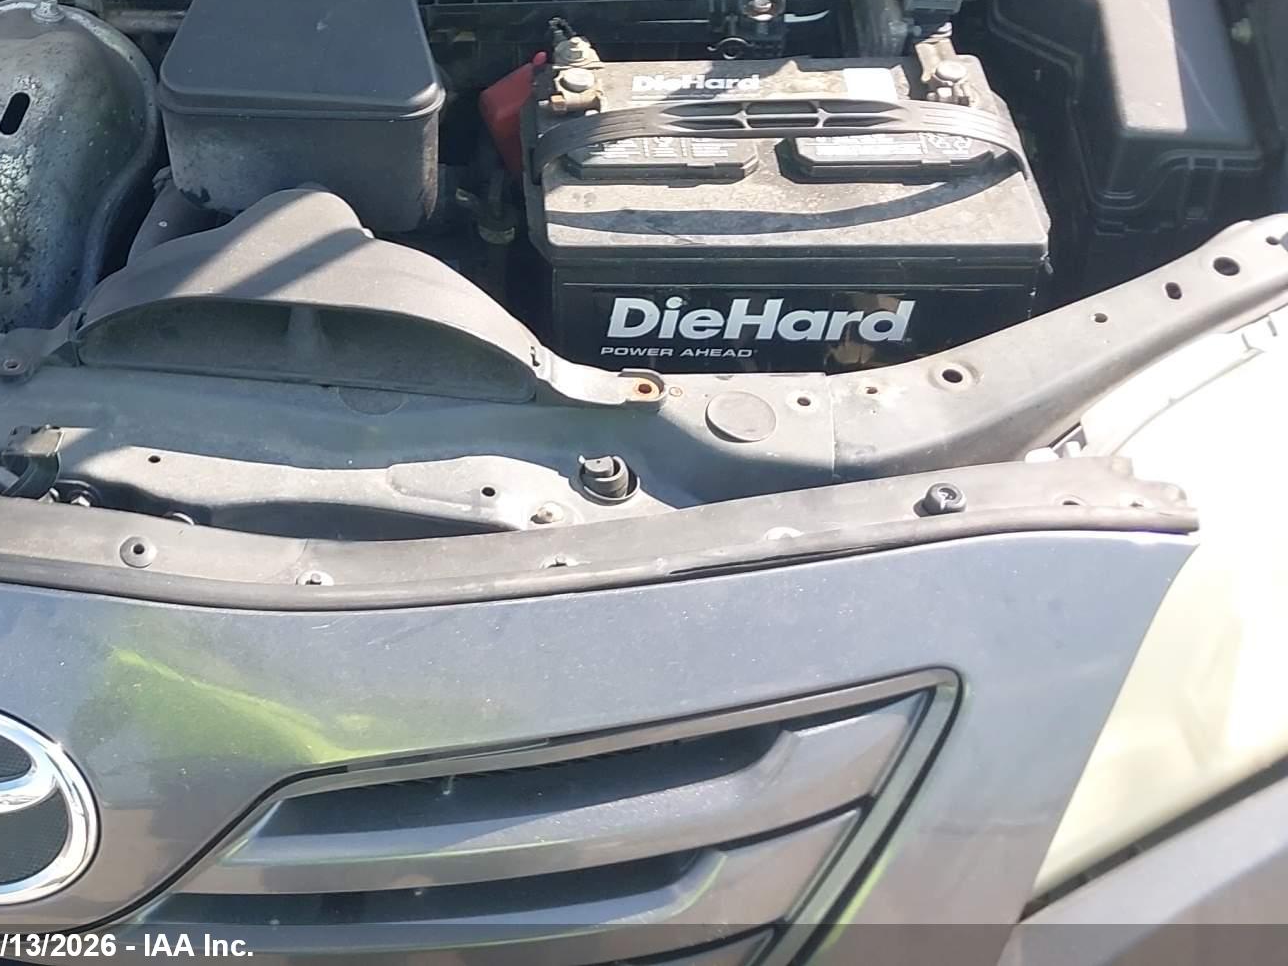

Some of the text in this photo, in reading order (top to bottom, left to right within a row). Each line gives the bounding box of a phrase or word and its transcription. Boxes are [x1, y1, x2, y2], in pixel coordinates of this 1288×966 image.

[631, 73, 761, 93] DieHard
[606, 295, 917, 343] DieHard
[600, 346, 755, 359] POWER AHEAD
